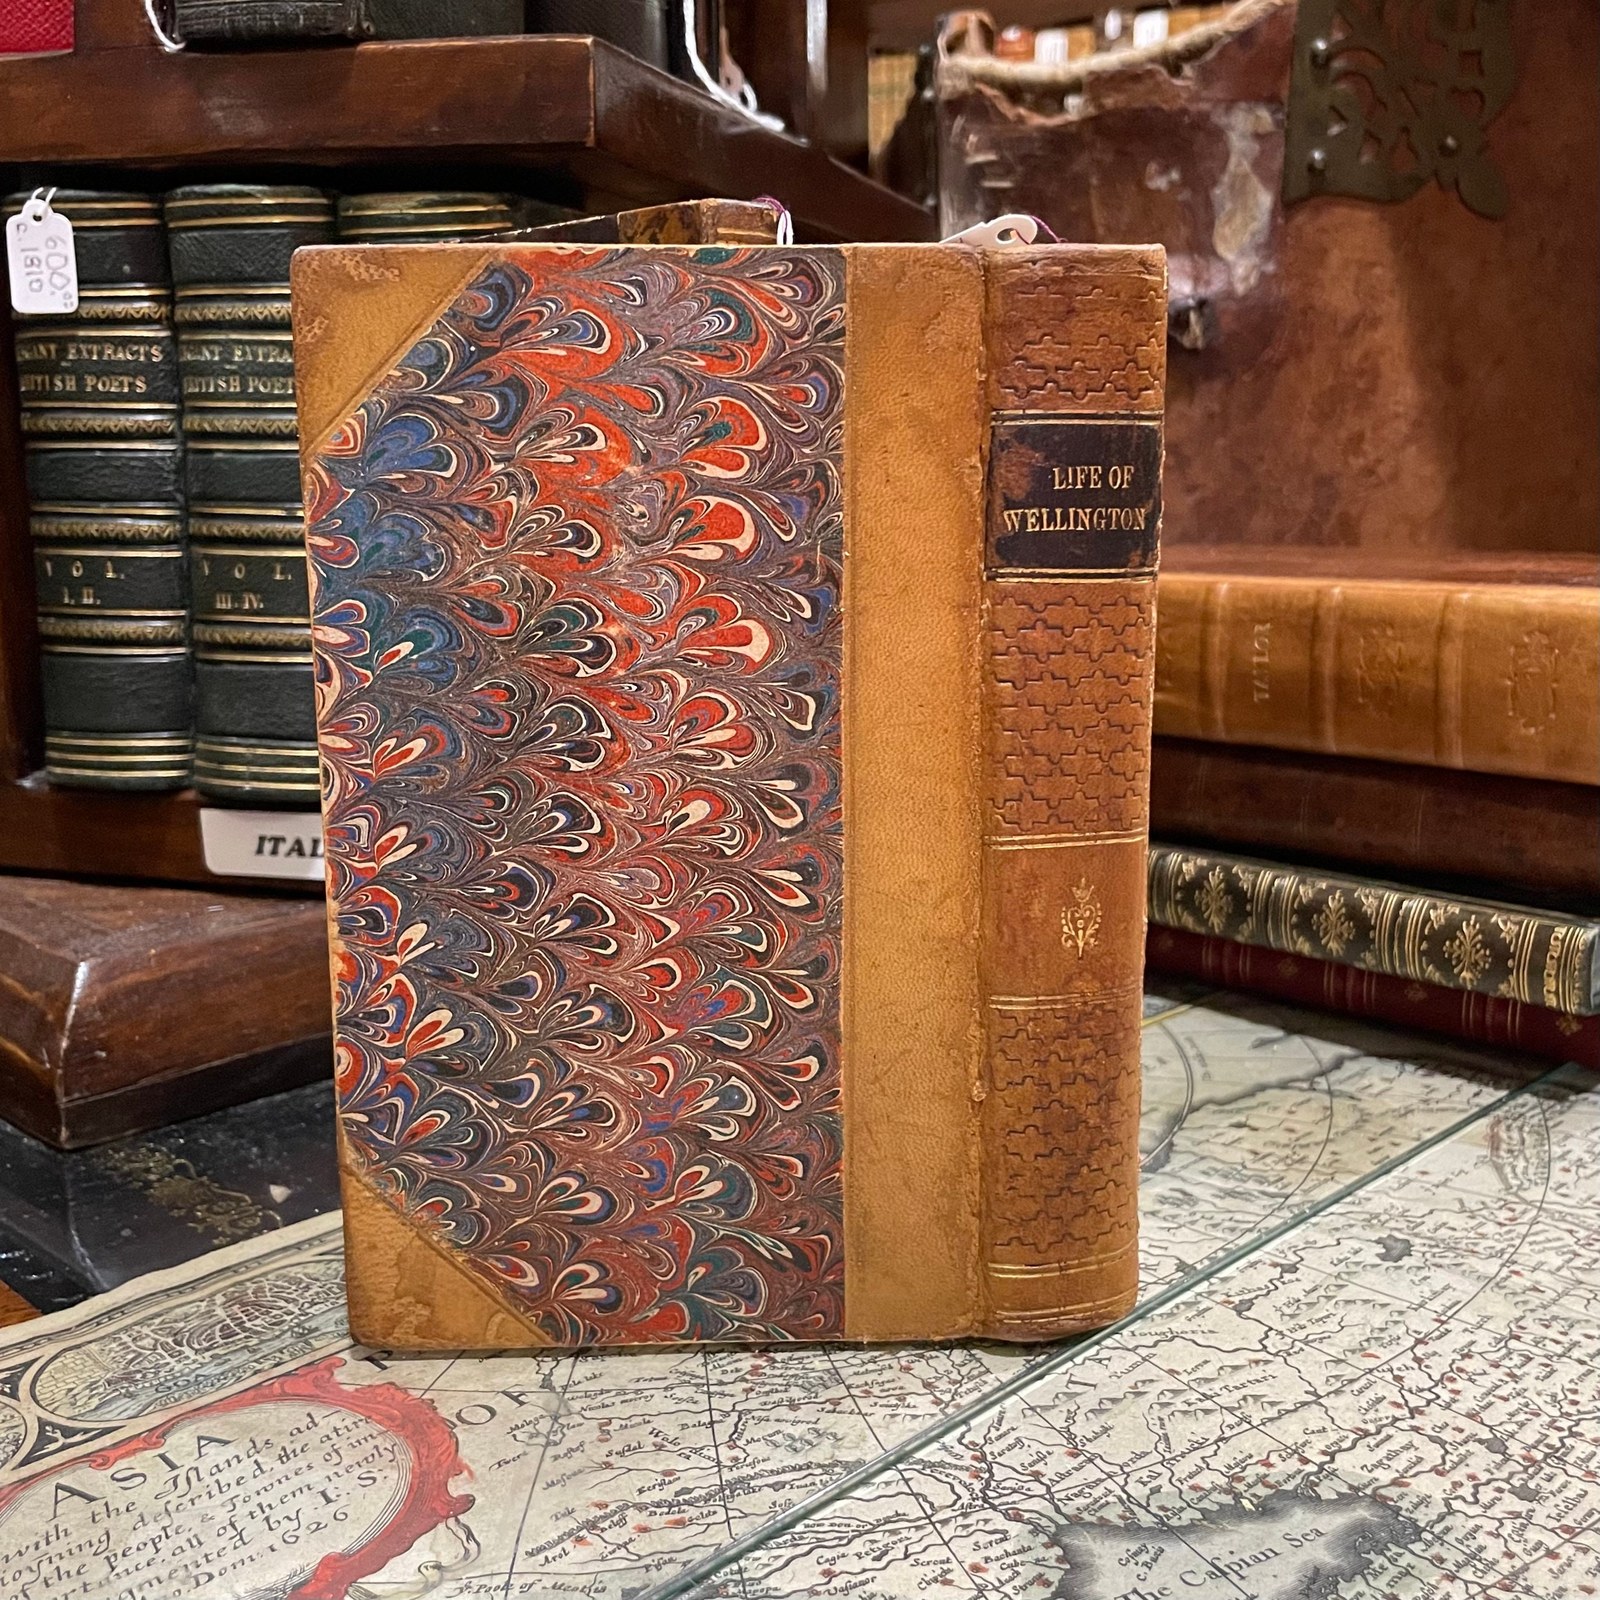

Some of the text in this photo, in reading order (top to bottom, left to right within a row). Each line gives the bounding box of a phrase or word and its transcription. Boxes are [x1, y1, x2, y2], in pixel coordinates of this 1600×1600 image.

[66, 342, 163, 363] EXTRACTS
[84, 374, 148, 394] POETS
[1052, 465, 1135, 490] LIFE OF
[1002, 506, 1146, 533] WELLINGTON
[278, 1441, 311, 1465] the
[46, 1435, 240, 1522] ASIA
[43, 1562, 90, 1589] the
[323, 1443, 343, 1467] of
[90, 1500, 138, 1524] the
[262, 1507, 303, 1536] by
[267, 1504, 350, 1553] 1626
[1282, 1526, 1329, 1550] Sea
